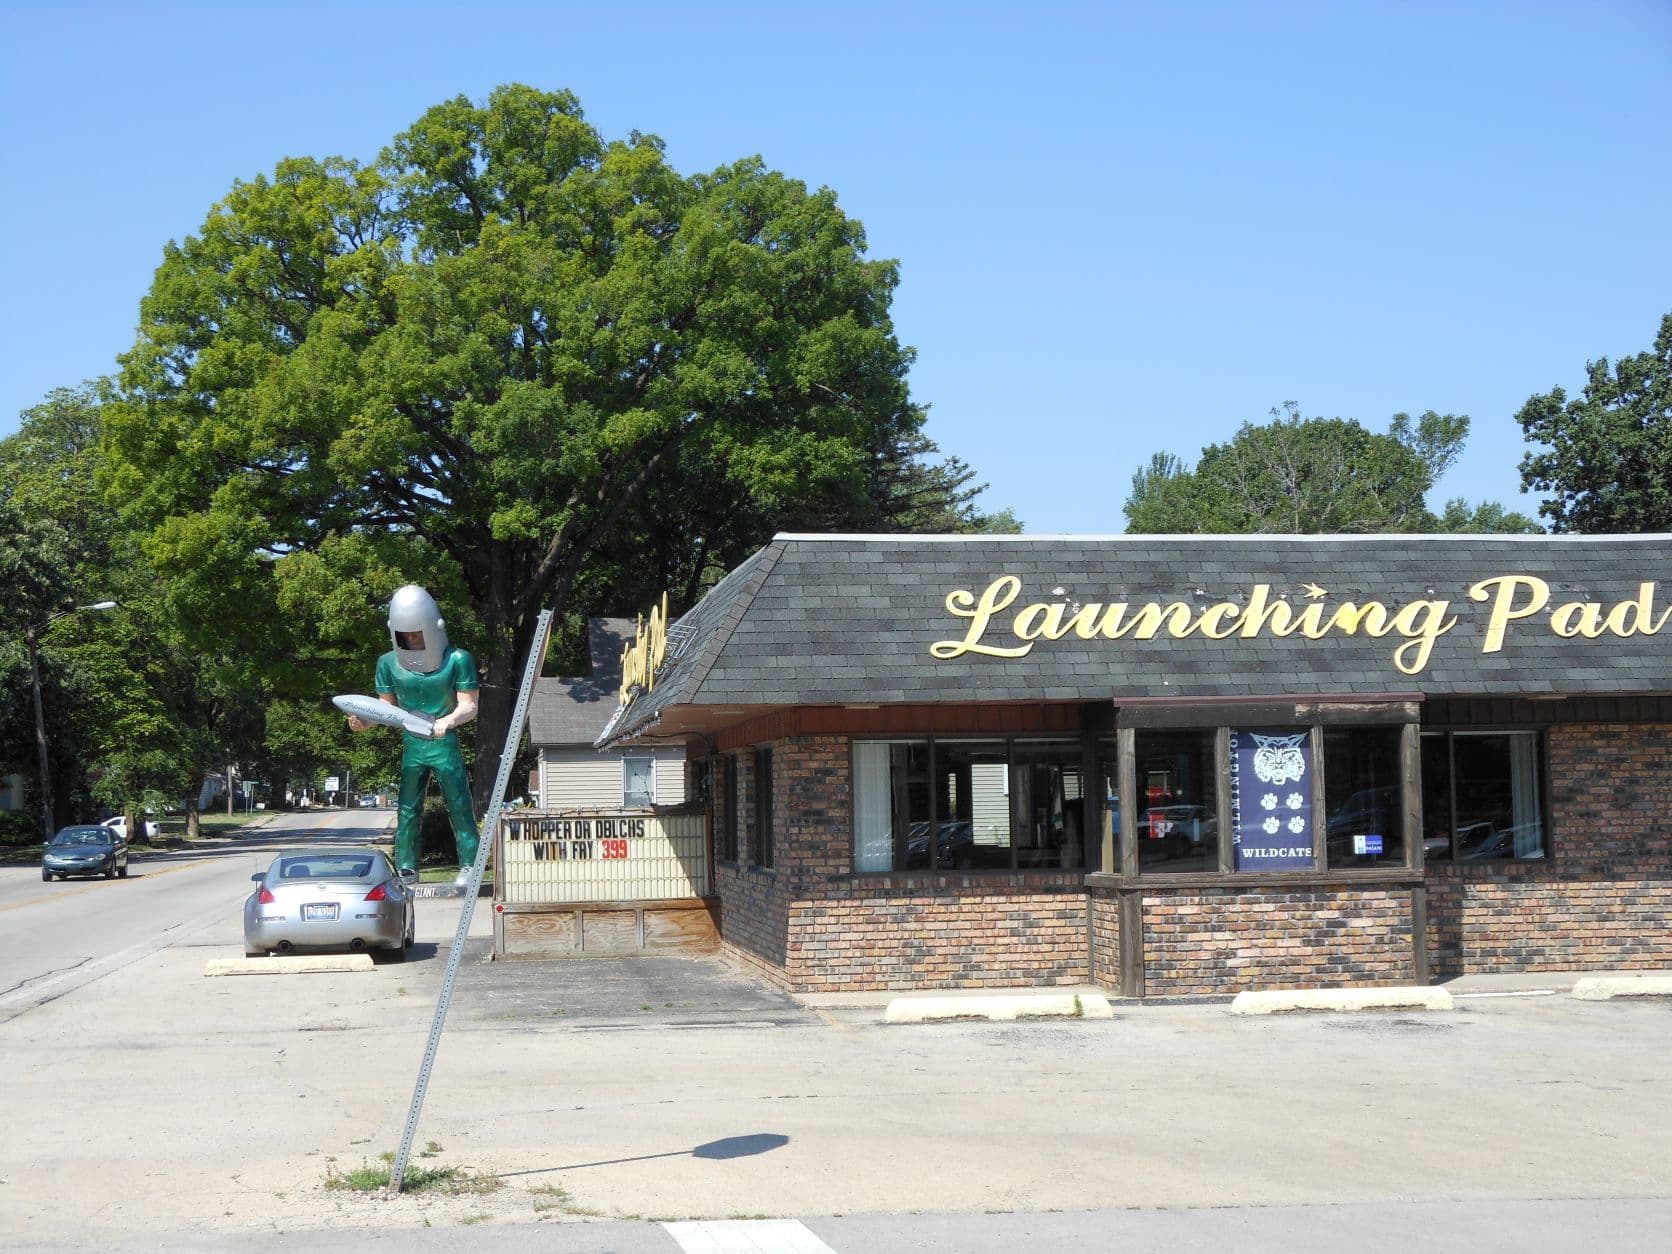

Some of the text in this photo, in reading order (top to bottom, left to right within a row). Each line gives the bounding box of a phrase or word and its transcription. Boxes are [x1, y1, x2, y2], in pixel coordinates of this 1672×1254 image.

[930, 575, 1672, 674] Launching Pad
[574, 820, 591, 839] OR
[595, 819, 645, 838] DBLCHS
[533, 839, 628, 860] WITH FRY 399
[1242, 847, 1312, 858] WILDCATS
[414, 887, 436, 898] GIANT
